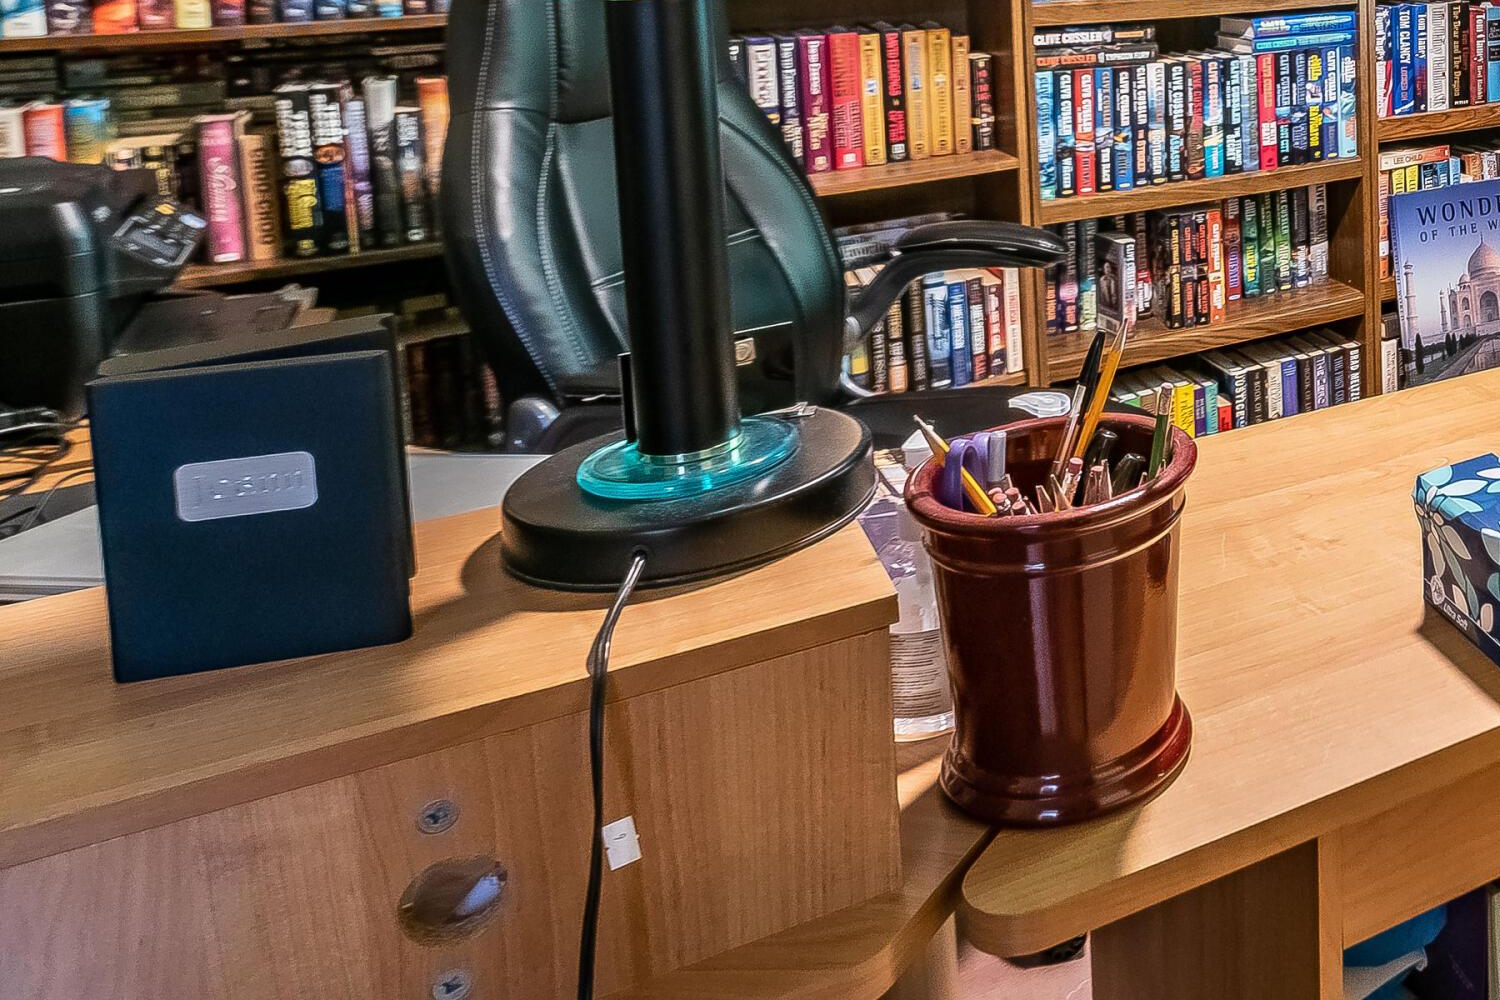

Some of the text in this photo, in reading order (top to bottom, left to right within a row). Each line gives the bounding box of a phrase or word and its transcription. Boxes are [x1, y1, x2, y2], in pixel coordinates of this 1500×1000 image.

[1452, 5, 1460, 18] The
[1475, 14, 1485, 31] Tom
[886, 33, 900, 58] DAVID
[1033, 33, 1103, 46] CLIVE CUSSLER
[1400, 10, 1411, 64] TOM CLANCY
[1415, 32, 1427, 59] Clancy
[1473, 34, 1486, 63] Clancy
[780, 42, 797, 107] DAVID EDDINGS
[1328, 51, 1336, 71] CLIVE
[1453, 56, 1461, 68] The
[1280, 54, 1290, 106] CLIVE CUSSLER
[1451, 70, 1461, 96] Dragon
[1060, 74, 1072, 135] CLIVE CUSSLER
[1081, 74, 1092, 132] CLIVE CUSSLER
[1102, 71, 1112, 127] CLIVE CUSSLER
[1119, 71, 1130, 127] CLIVE CUSSLER
[1136, 67, 1147, 124] CLIVE CUSSLER
[1172, 66, 1184, 130] CLIVE CUSSLER
[1393, 154, 1423, 165] LEE CHILD
[1419, 229, 1438, 243] OF
[1449, 223, 1478, 238] THE
[1126, 244, 1135, 260] CLIVE
[1279, 243, 1290, 277] MIRAGE
[1350, 349, 1360, 402] BRAD MELTZE
[1457, 613, 1468, 631] Soft
